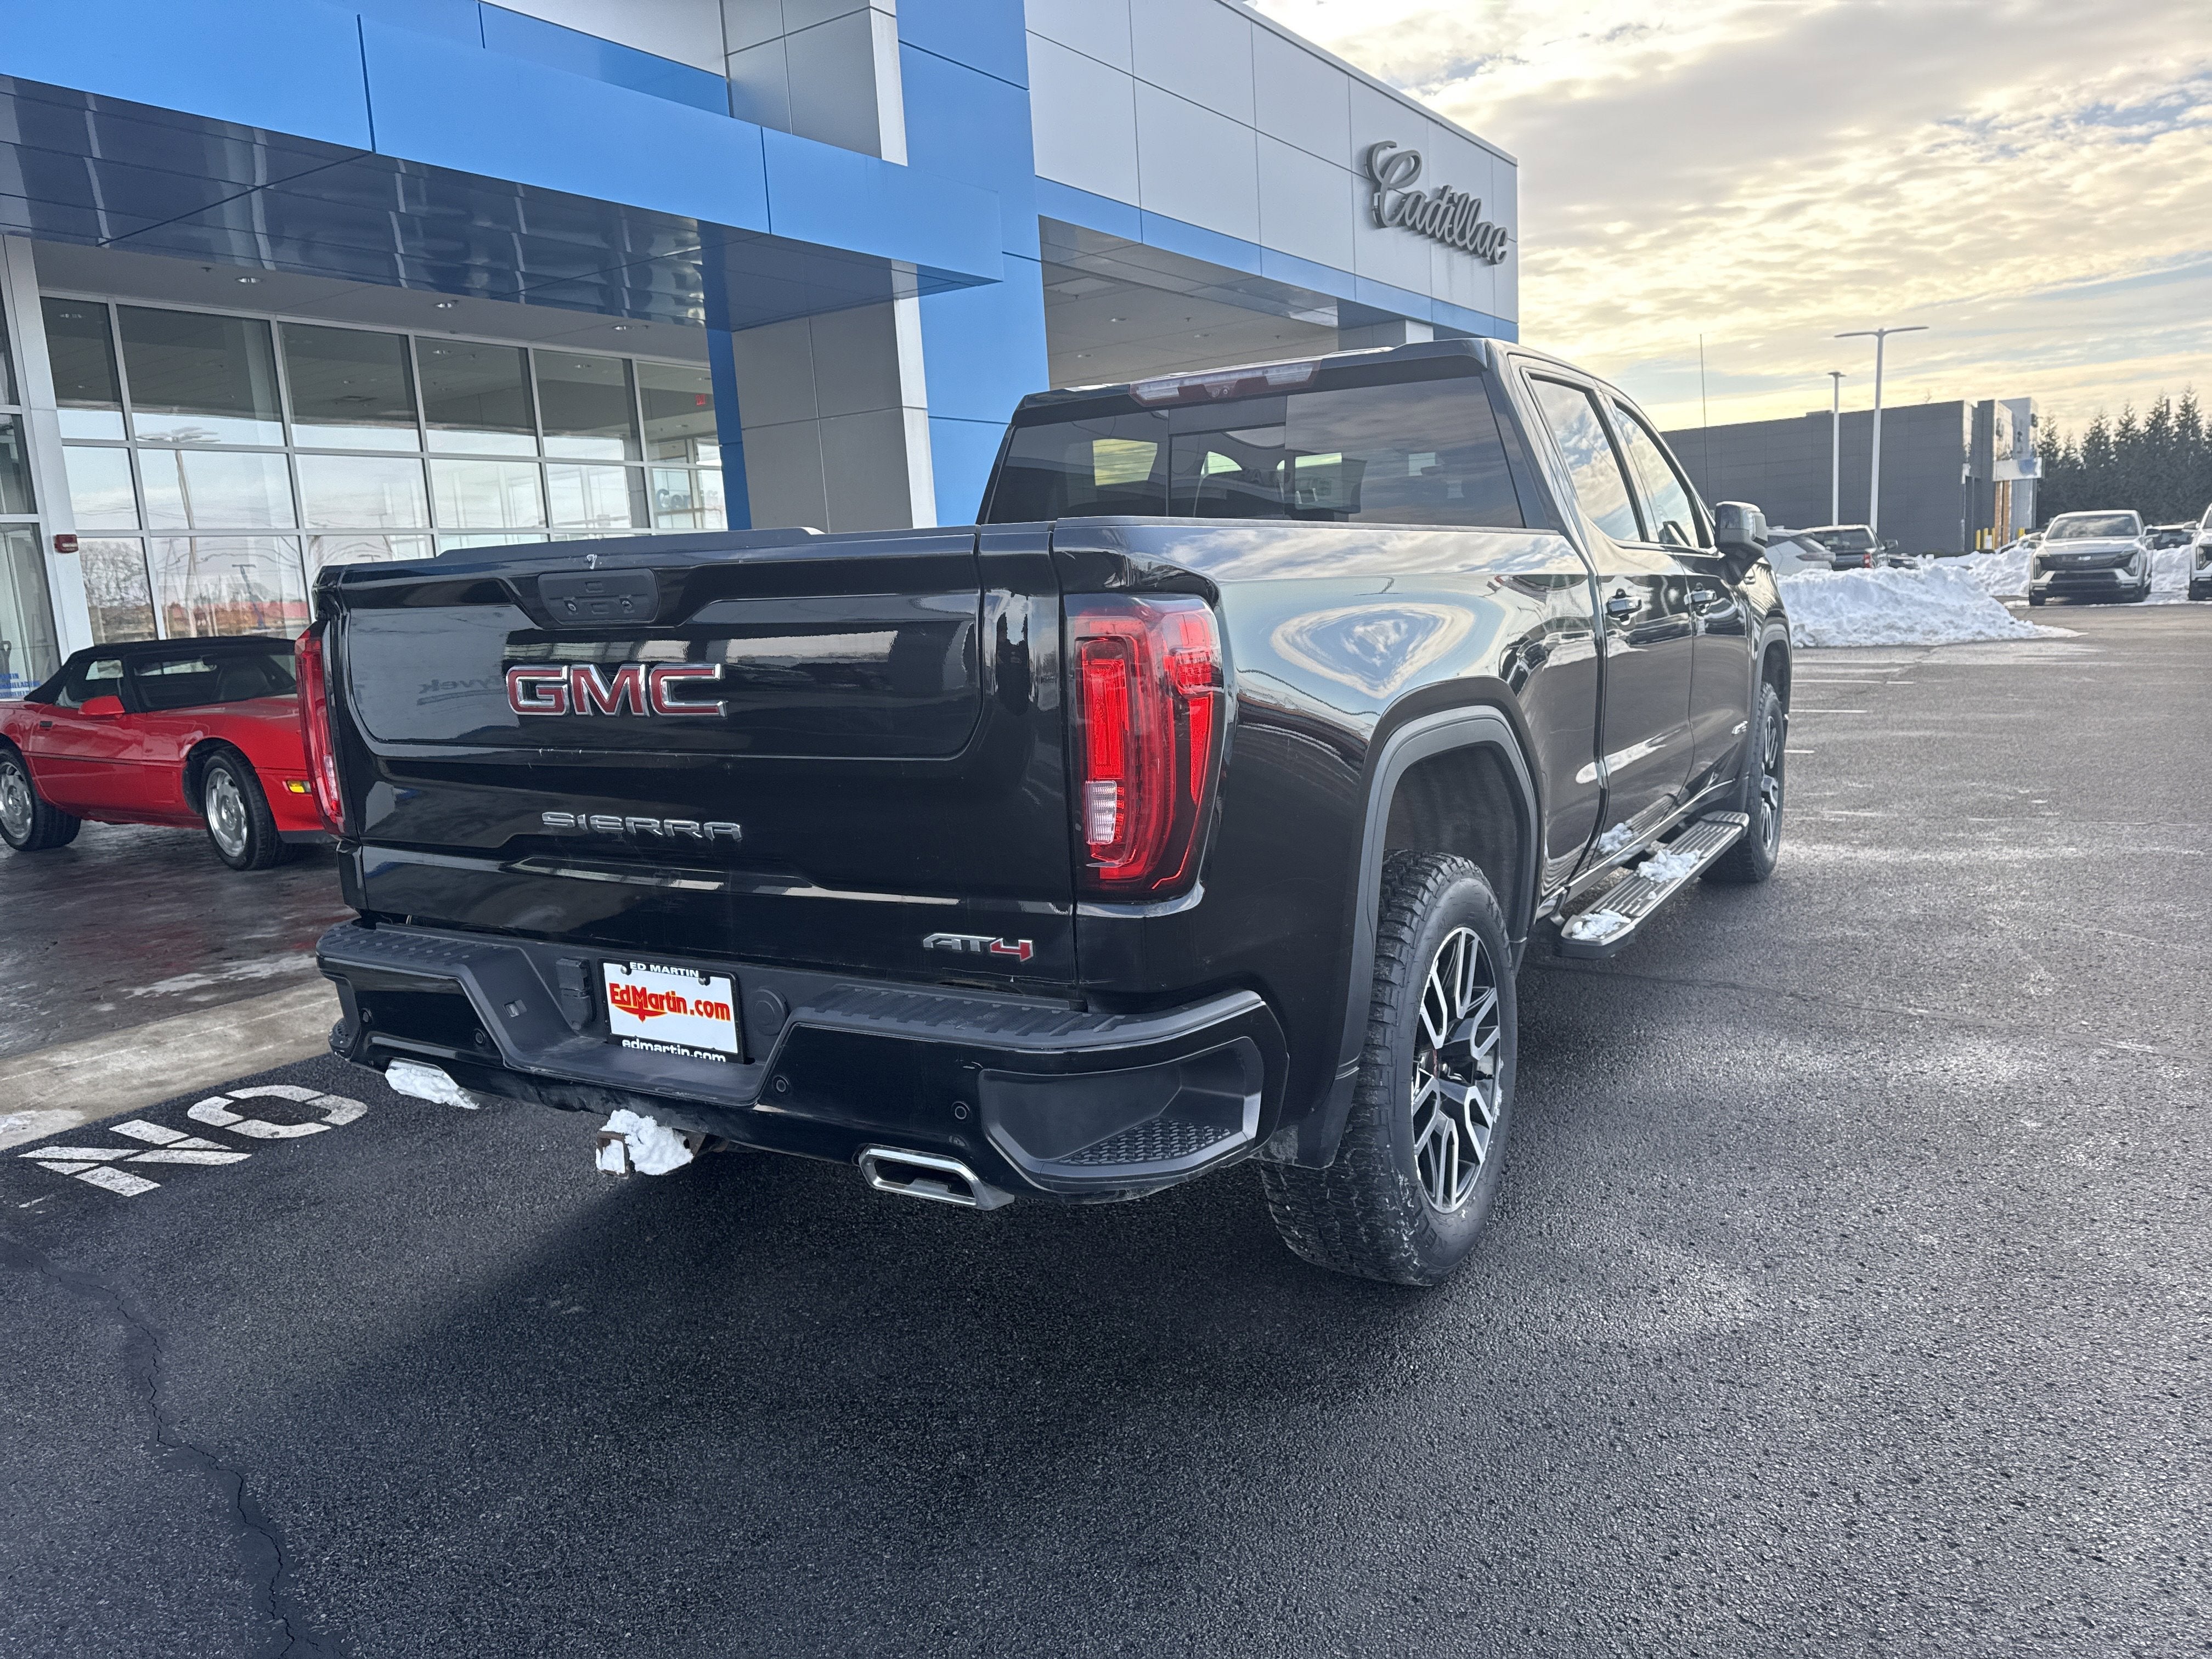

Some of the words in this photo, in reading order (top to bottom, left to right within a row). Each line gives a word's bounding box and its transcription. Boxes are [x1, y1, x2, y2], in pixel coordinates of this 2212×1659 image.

[1366, 140, 1508, 264] Cadillac
[506, 663, 729, 718] GMC
[542, 811, 742, 842] SIERRA
[923, 933, 1034, 962] AT4
[629, 962, 646, 971] ED
[650, 964, 699, 978] MARTIN
[608, 982, 731, 1022] EdMartin.com
[622, 1038, 726, 1063] edmartin.com
[17, 1085, 368, 1197] NO
